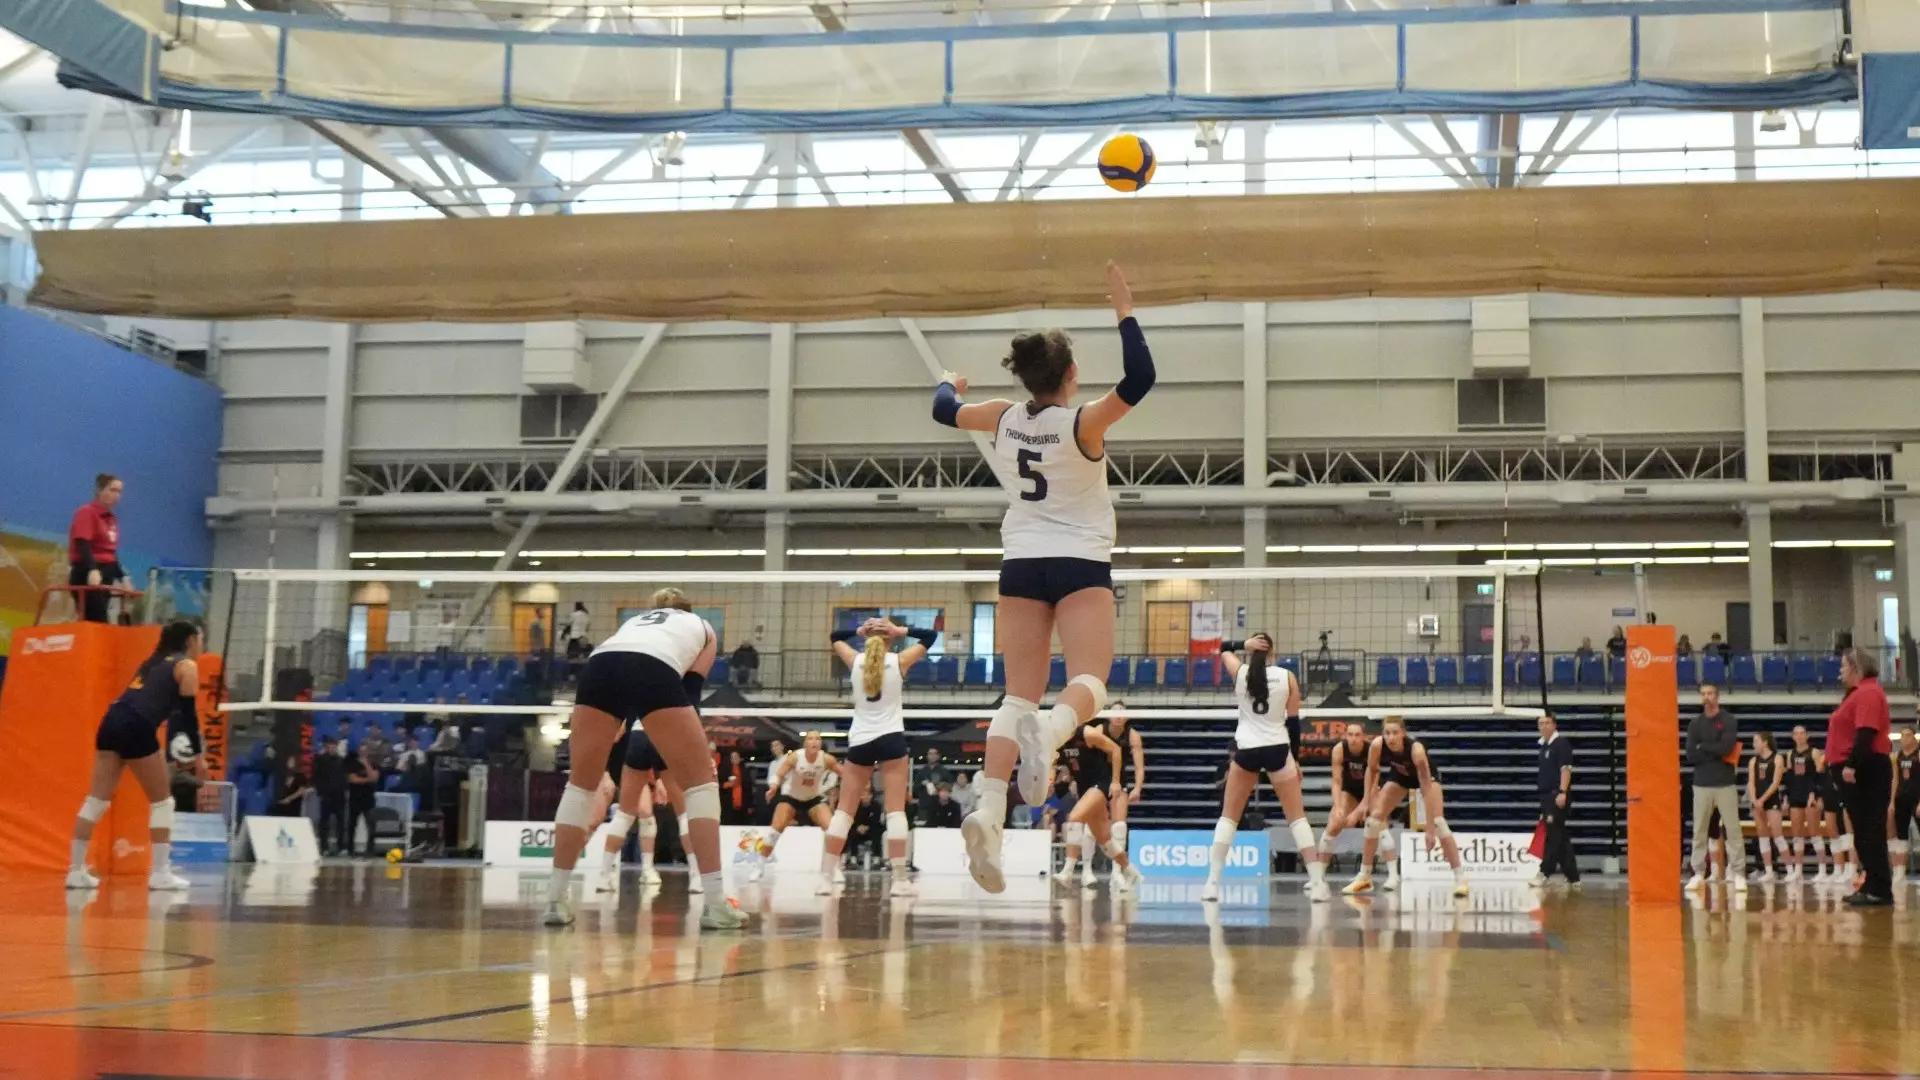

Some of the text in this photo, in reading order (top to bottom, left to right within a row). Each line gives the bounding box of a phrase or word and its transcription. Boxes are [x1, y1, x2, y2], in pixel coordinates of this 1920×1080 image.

[1016, 448, 1048, 502] 5
[635, 611, 670, 627] 9
[1310, 721, 1350, 739] TR
[520, 827, 558, 846] acr
[1138, 844, 1260, 868] GKSOND
[1410, 836, 1532, 863] Hadbite
